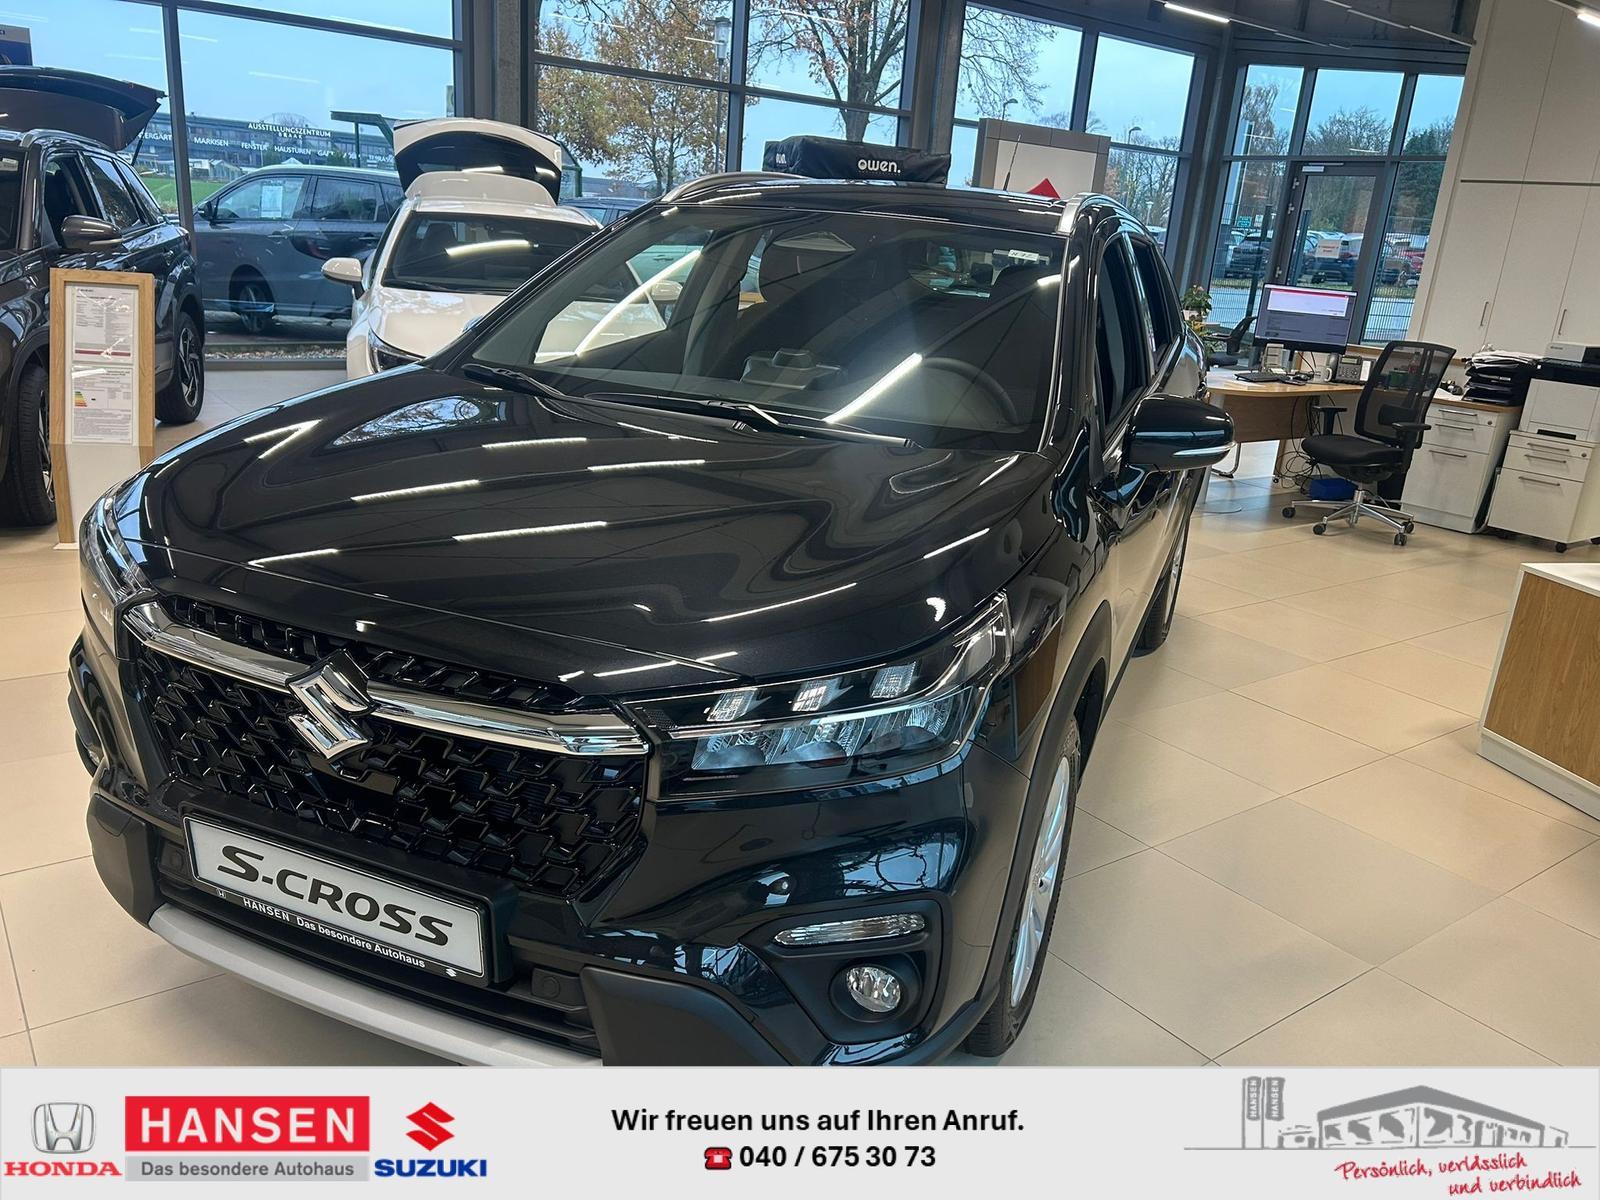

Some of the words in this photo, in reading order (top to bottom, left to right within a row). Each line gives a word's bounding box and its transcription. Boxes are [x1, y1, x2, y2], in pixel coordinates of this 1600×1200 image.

[248, 123, 331, 138] AUSSTELLUNGSZENTRUM
[194, 137, 229, 147] MARKISEN
[241, 142, 268, 151] FENSTER
[858, 159, 902, 174] owen.
[217, 845, 453, 947] S-CROSS
[243, 898, 290, 923] HANSEN
[296, 916, 316, 934] Das
[318, 920, 372, 951] besondere
[374, 943, 426, 969] Autohaus
